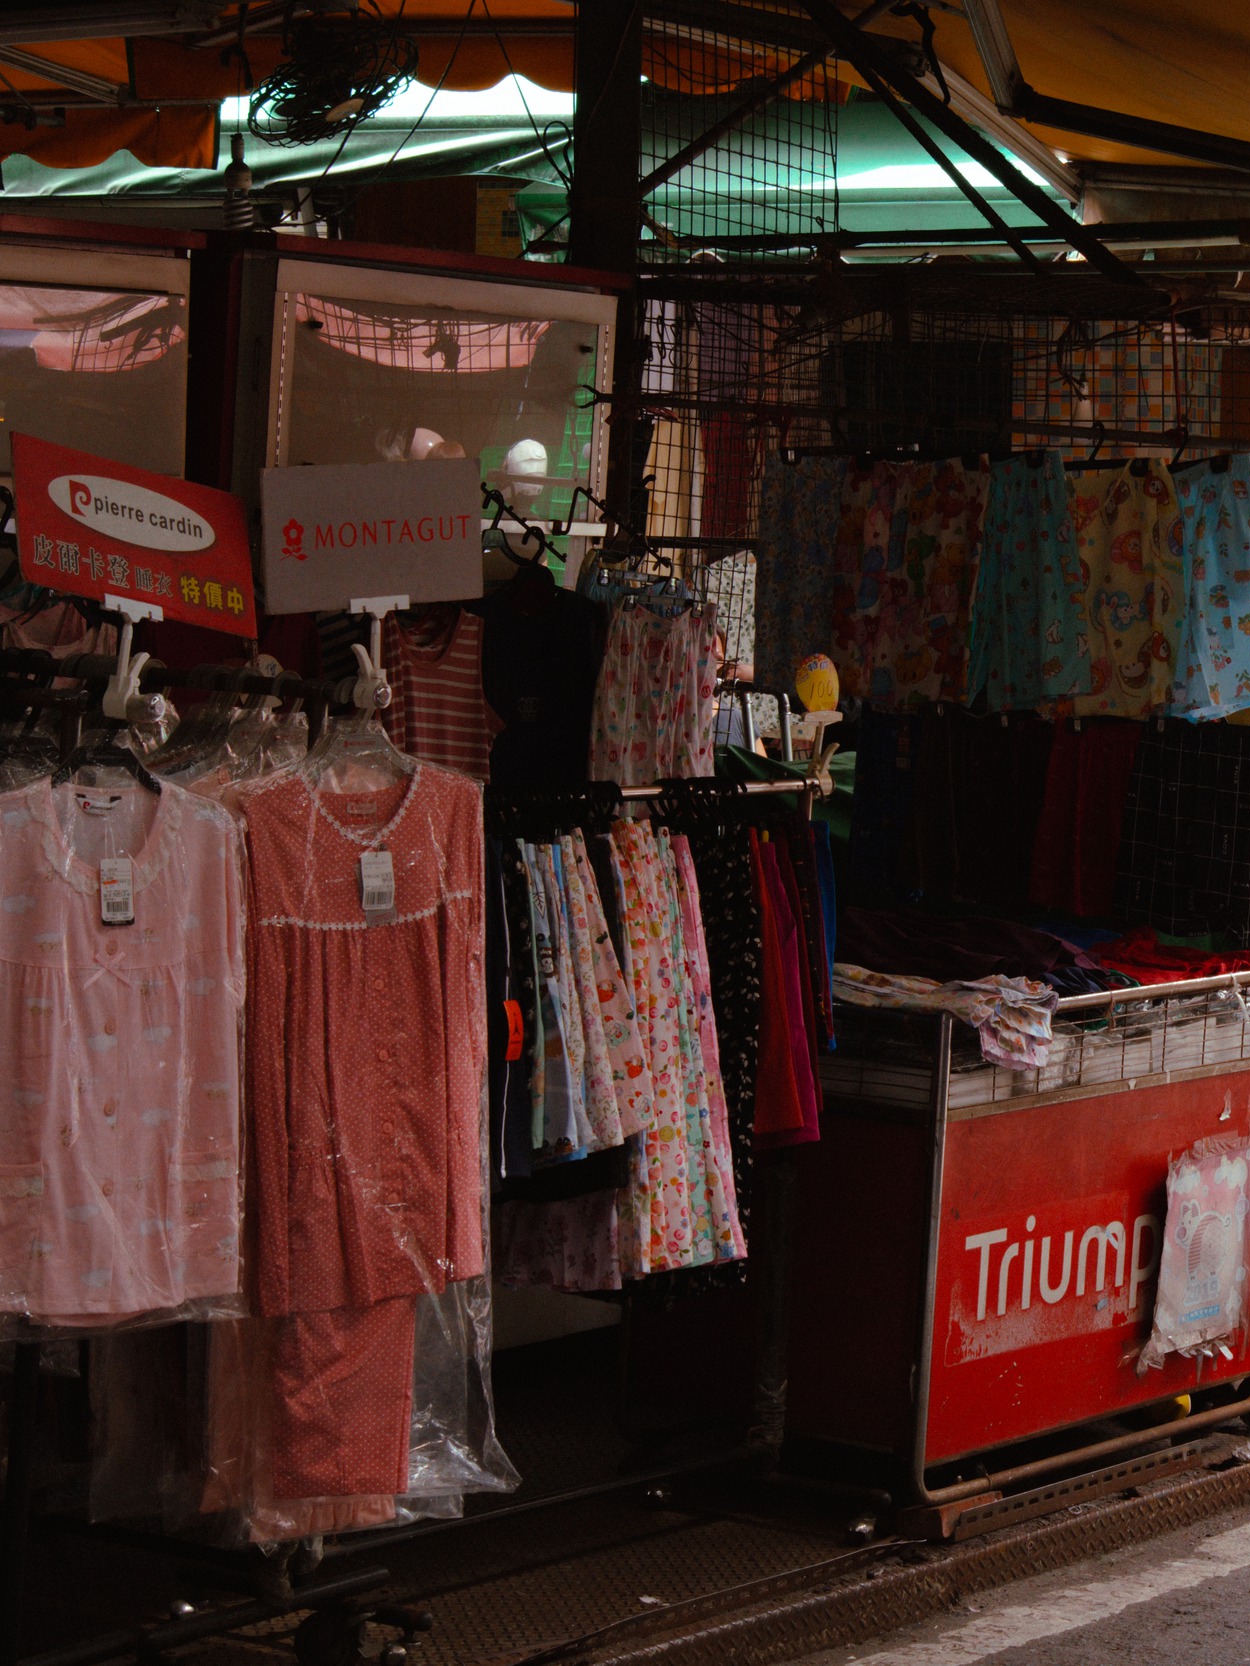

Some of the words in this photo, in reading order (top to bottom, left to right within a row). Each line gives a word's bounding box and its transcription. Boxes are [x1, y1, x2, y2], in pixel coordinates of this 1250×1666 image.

[94, 496, 144, 523] pierre
[149, 512, 203, 539] cardin
[315, 515, 471, 549] MONTAGUT
[181, 575, 244, 614] 特價中
[810, 680, 834, 700] 100
[965, 1214, 1160, 1321] Triump
